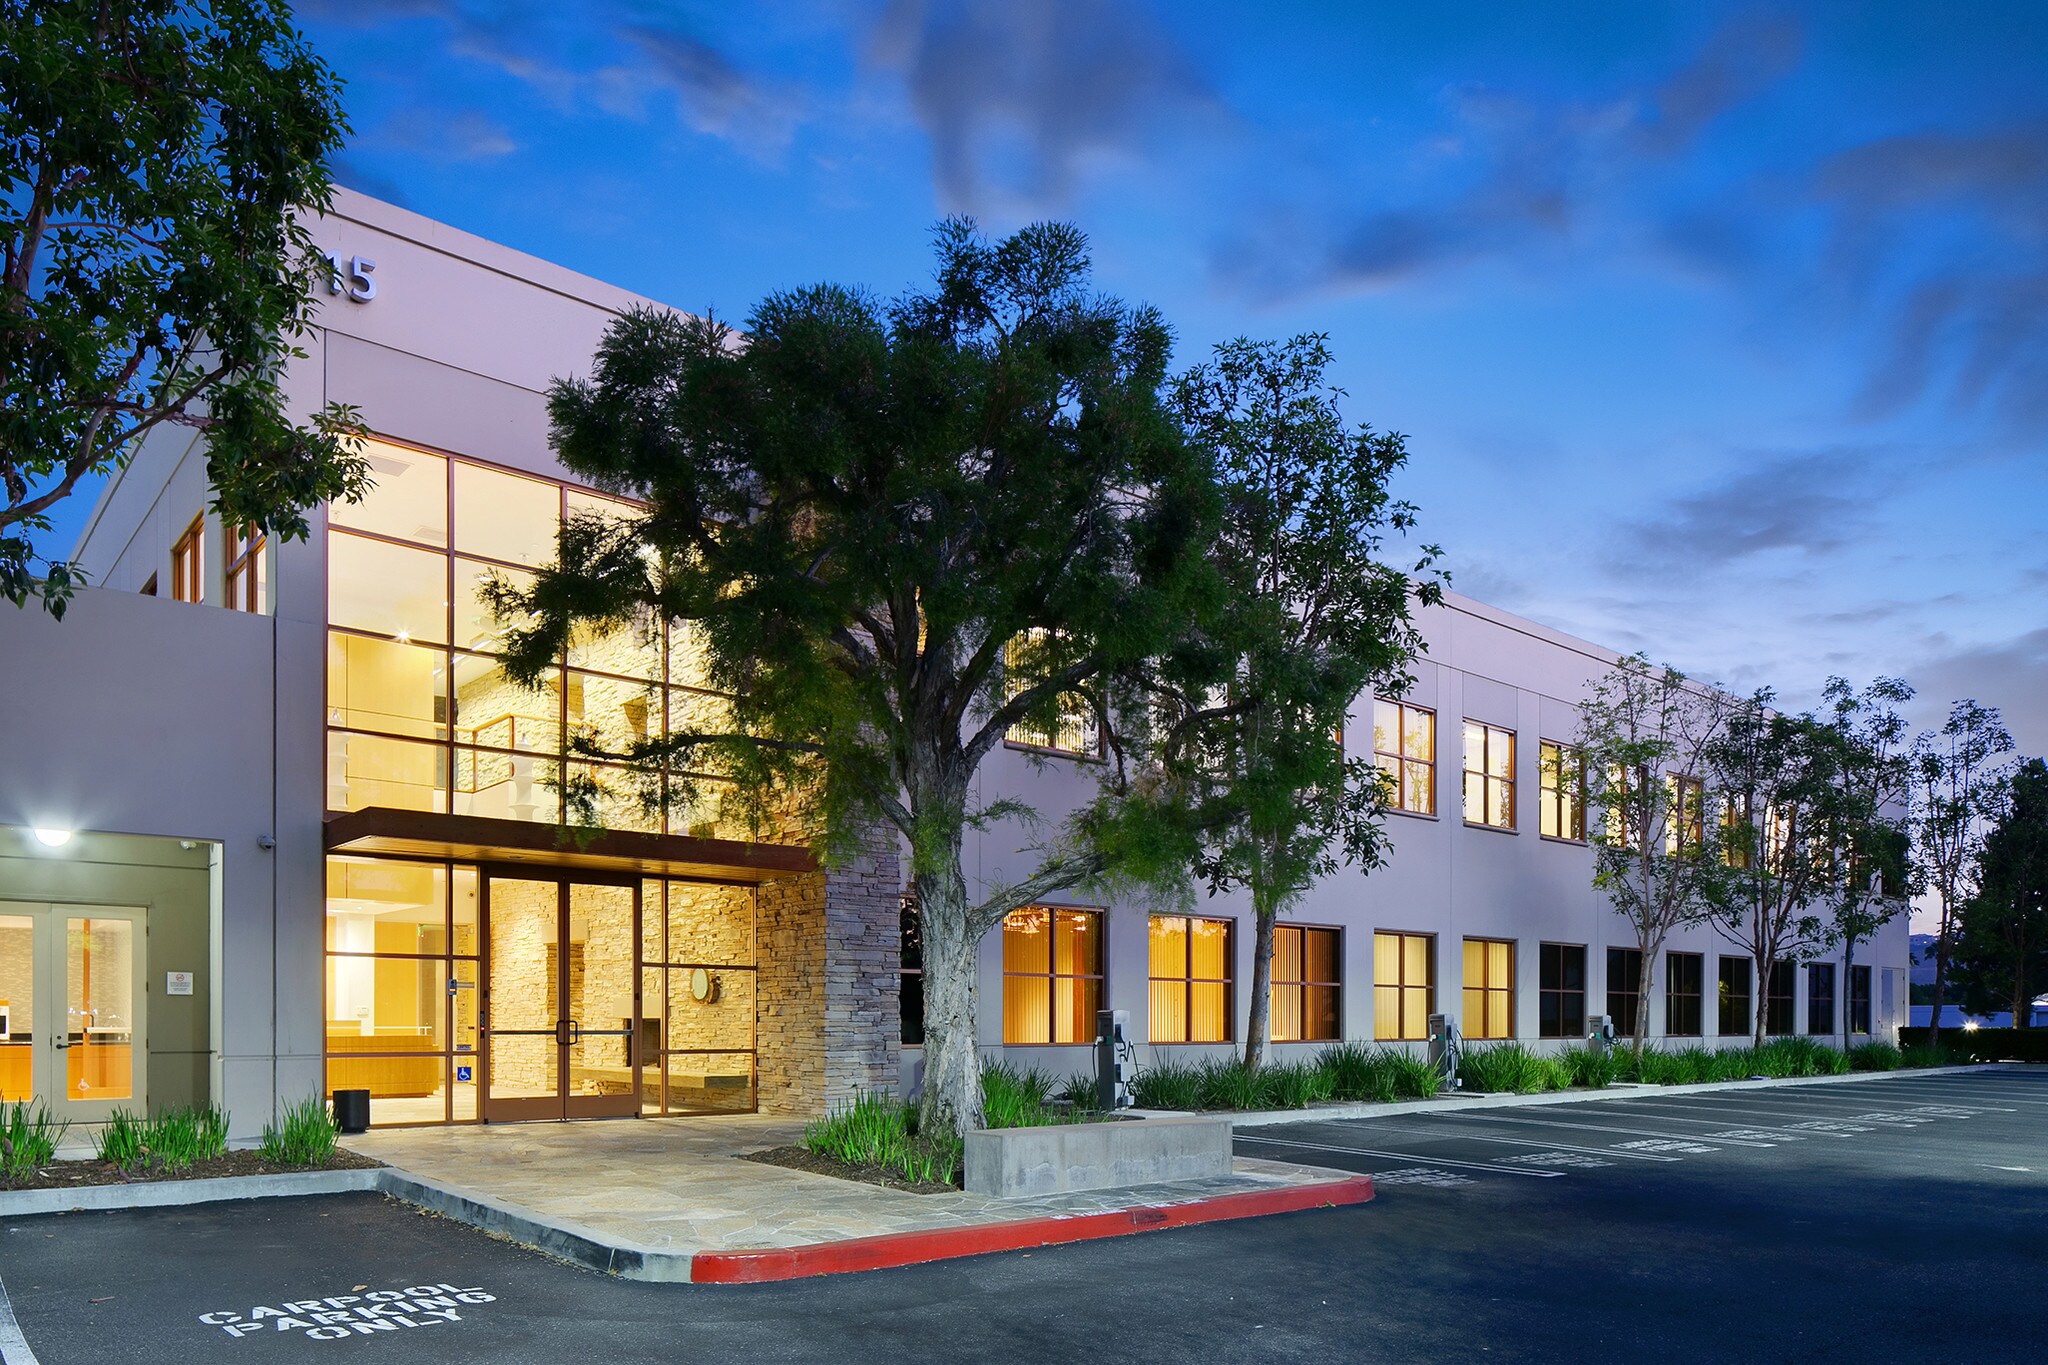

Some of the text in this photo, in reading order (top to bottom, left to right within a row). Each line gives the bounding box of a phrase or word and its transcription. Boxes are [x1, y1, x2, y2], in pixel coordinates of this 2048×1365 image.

[198, 1283, 484, 1325] CARPOOL
[222, 1291, 497, 1338] PARKING
[305, 1308, 463, 1340] ONLY
